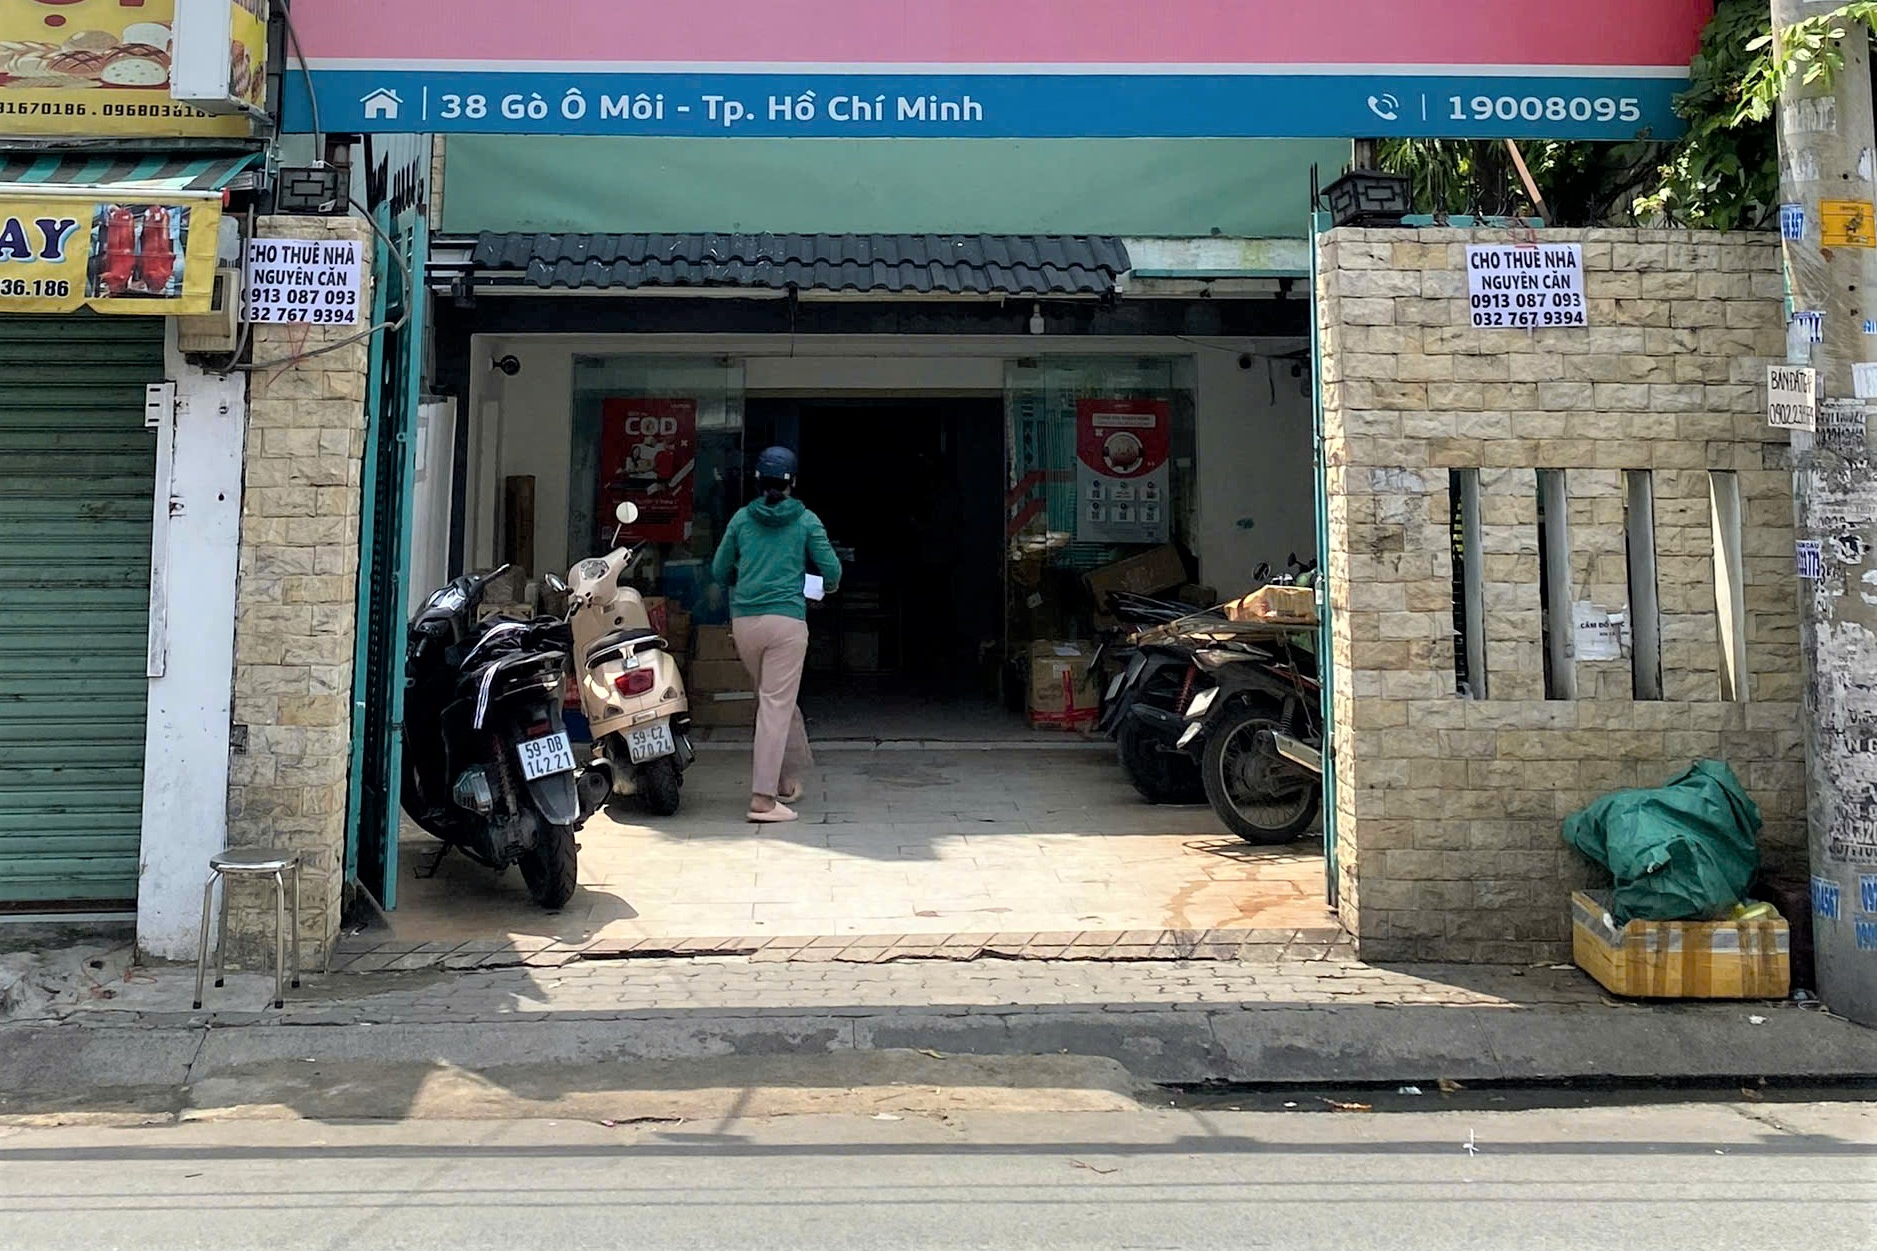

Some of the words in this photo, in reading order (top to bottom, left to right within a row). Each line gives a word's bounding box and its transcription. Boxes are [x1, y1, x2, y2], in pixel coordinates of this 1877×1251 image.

[440, 94, 487, 120] 38
[501, 92, 548, 120] Gò
[561, 87, 586, 120] Ô
[600, 93, 663, 120] Môi
[702, 95, 755, 127] Tp.
[768, 89, 816, 121] Hồ
[828, 94, 886, 121] Chí
[898, 95, 983, 121] Minh
[1450, 95, 1641, 122] 19008095
[282, 242, 319, 264] THUÊ
[324, 242, 355, 265] NHÀ
[1471, 251, 1500, 269] CHO
[1544, 246, 1576, 268] NHÀ
[254, 266, 313, 286] NGUYÊN
[318, 266, 347, 286] CĂN
[1482, 271, 1539, 289] NGUYÊN
[1543, 270, 1570, 289] CĂN
[287, 289, 319, 304] 087
[325, 290, 356, 305] 093
[1471, 293, 1510, 308] 0913
[1516, 293, 1546, 308] 087
[1552, 293, 1581, 307] 093
[277, 308, 308, 322] 767
[313, 309, 355, 323] 9394
[1473, 312, 1503, 326] 032
[1508, 312, 1538, 326] 767
[1543, 311, 1584, 325] 9394
[525, 735, 563, 759] 59-DB
